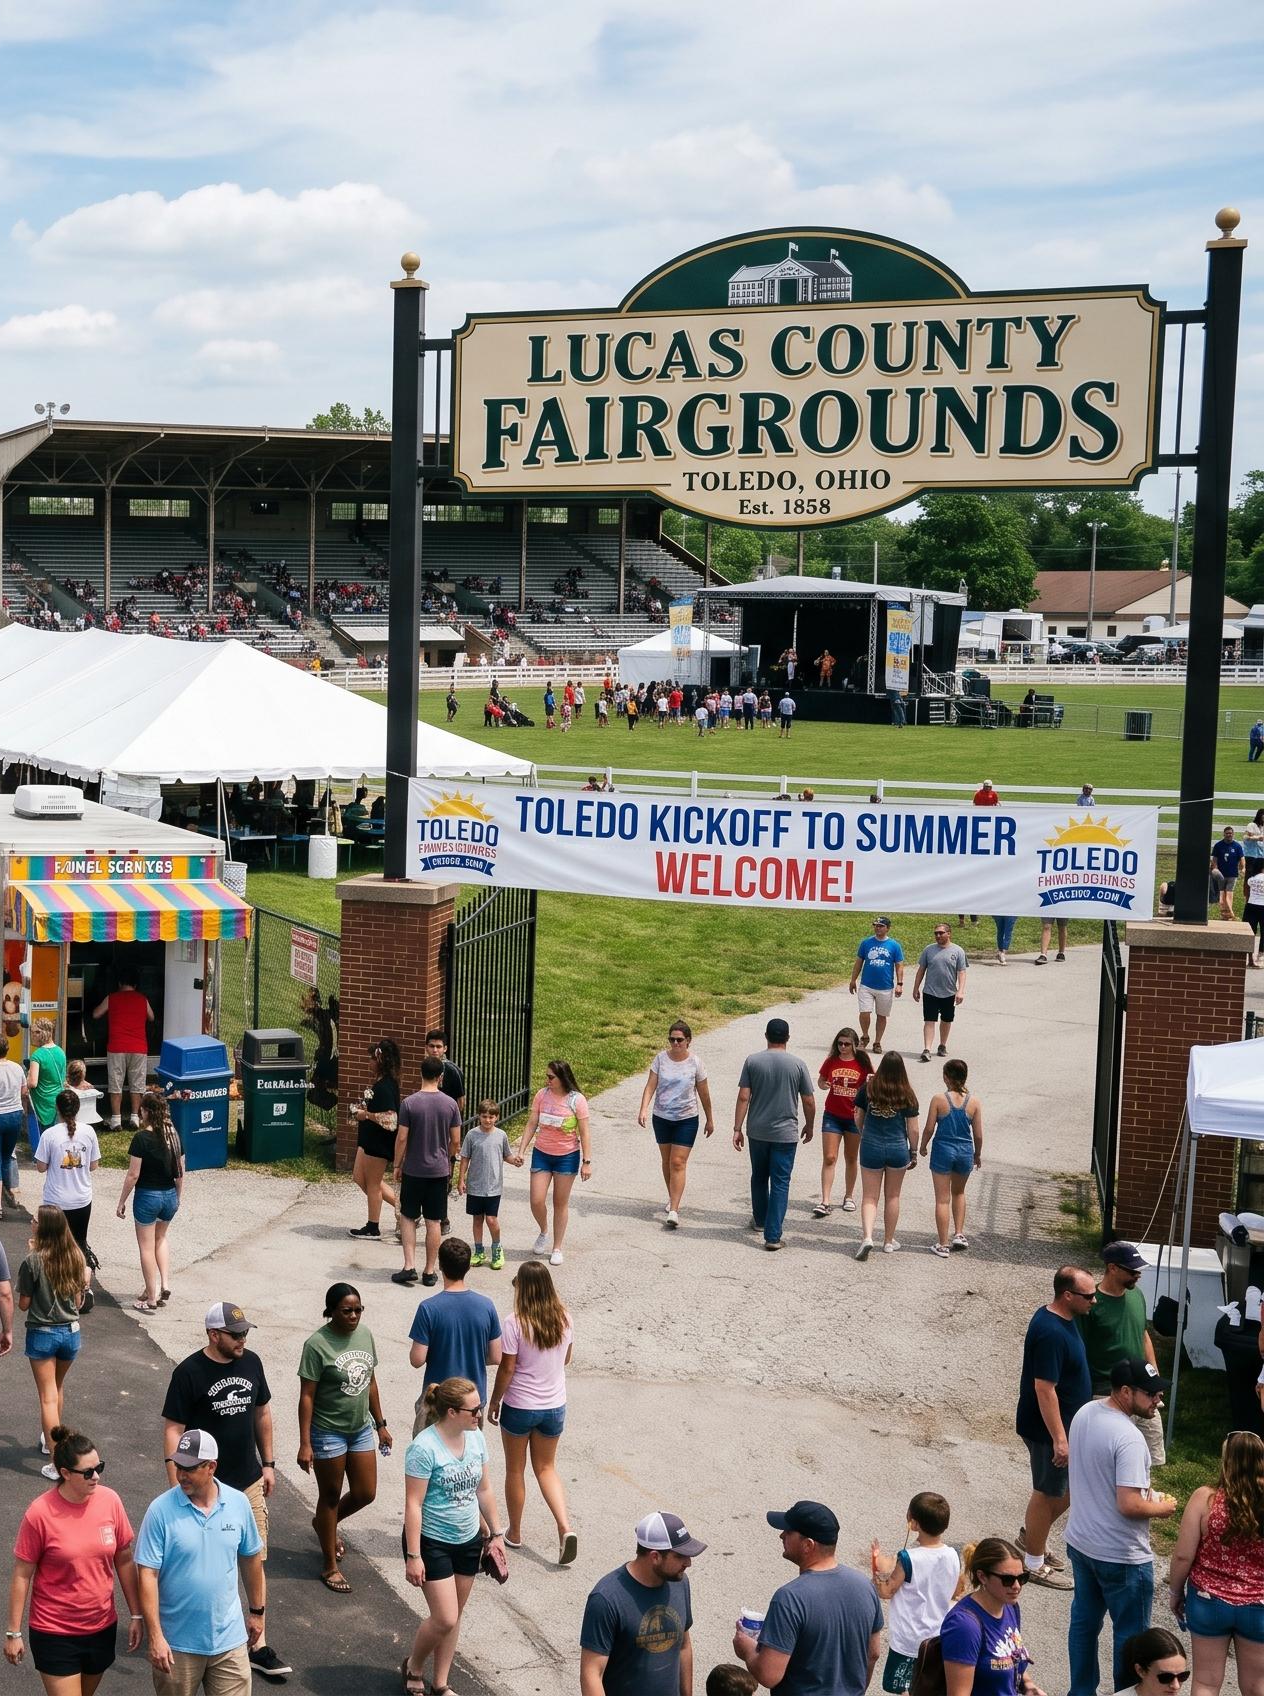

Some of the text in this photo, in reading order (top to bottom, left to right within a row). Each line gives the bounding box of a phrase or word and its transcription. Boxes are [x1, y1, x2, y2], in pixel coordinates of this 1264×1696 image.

[526, 313, 1078, 386] LUCAS COUNTY
[480, 380, 1122, 470] FAIRGROUNDS
[682, 468, 891, 494] TOLEDO, OHIO
[738, 498, 831, 515] Est. 1858
[416, 818, 499, 847] TOLEDO
[514, 795, 1018, 857] TOLEDO KICKOFF TO SUMMER
[655, 851, 854, 904] WELCOME!
[1036, 846, 1138, 875] TOLEDO
